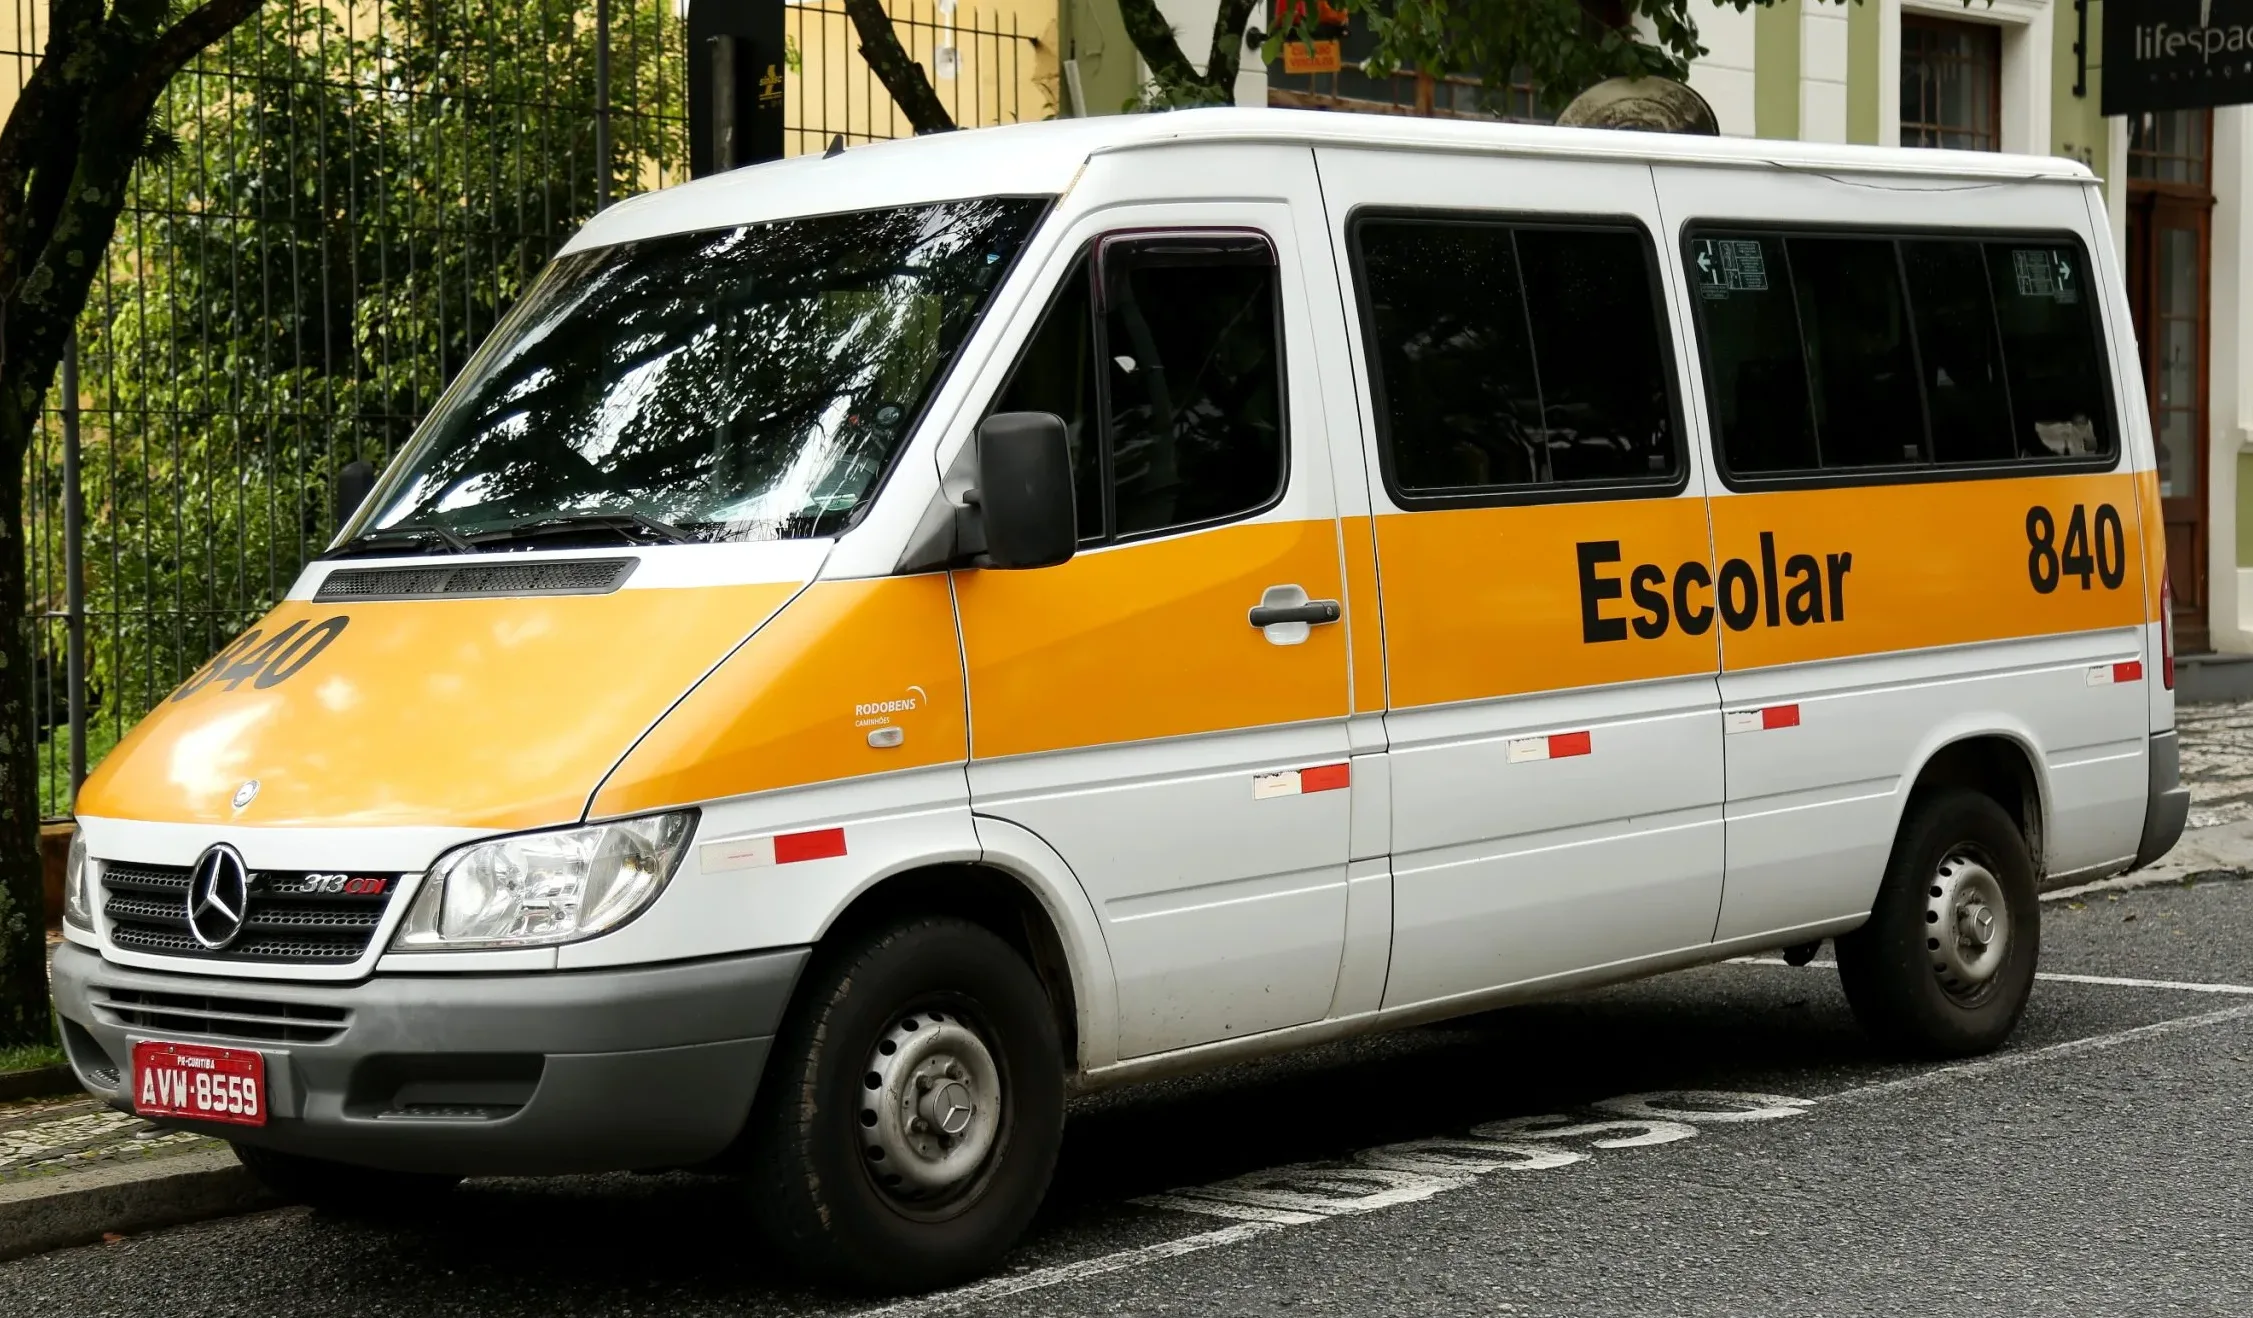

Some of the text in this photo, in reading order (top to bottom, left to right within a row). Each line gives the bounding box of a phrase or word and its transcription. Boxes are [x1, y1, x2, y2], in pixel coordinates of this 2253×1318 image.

[2025, 502, 2125, 594] 840
[1576, 531, 1852, 643] Escolar
[171, 615, 350, 702] 840
[855, 698, 916, 716] RODOBENS
[300, 874, 388, 895] 313 CDI
[142, 1067, 258, 1116] AVW-8559
